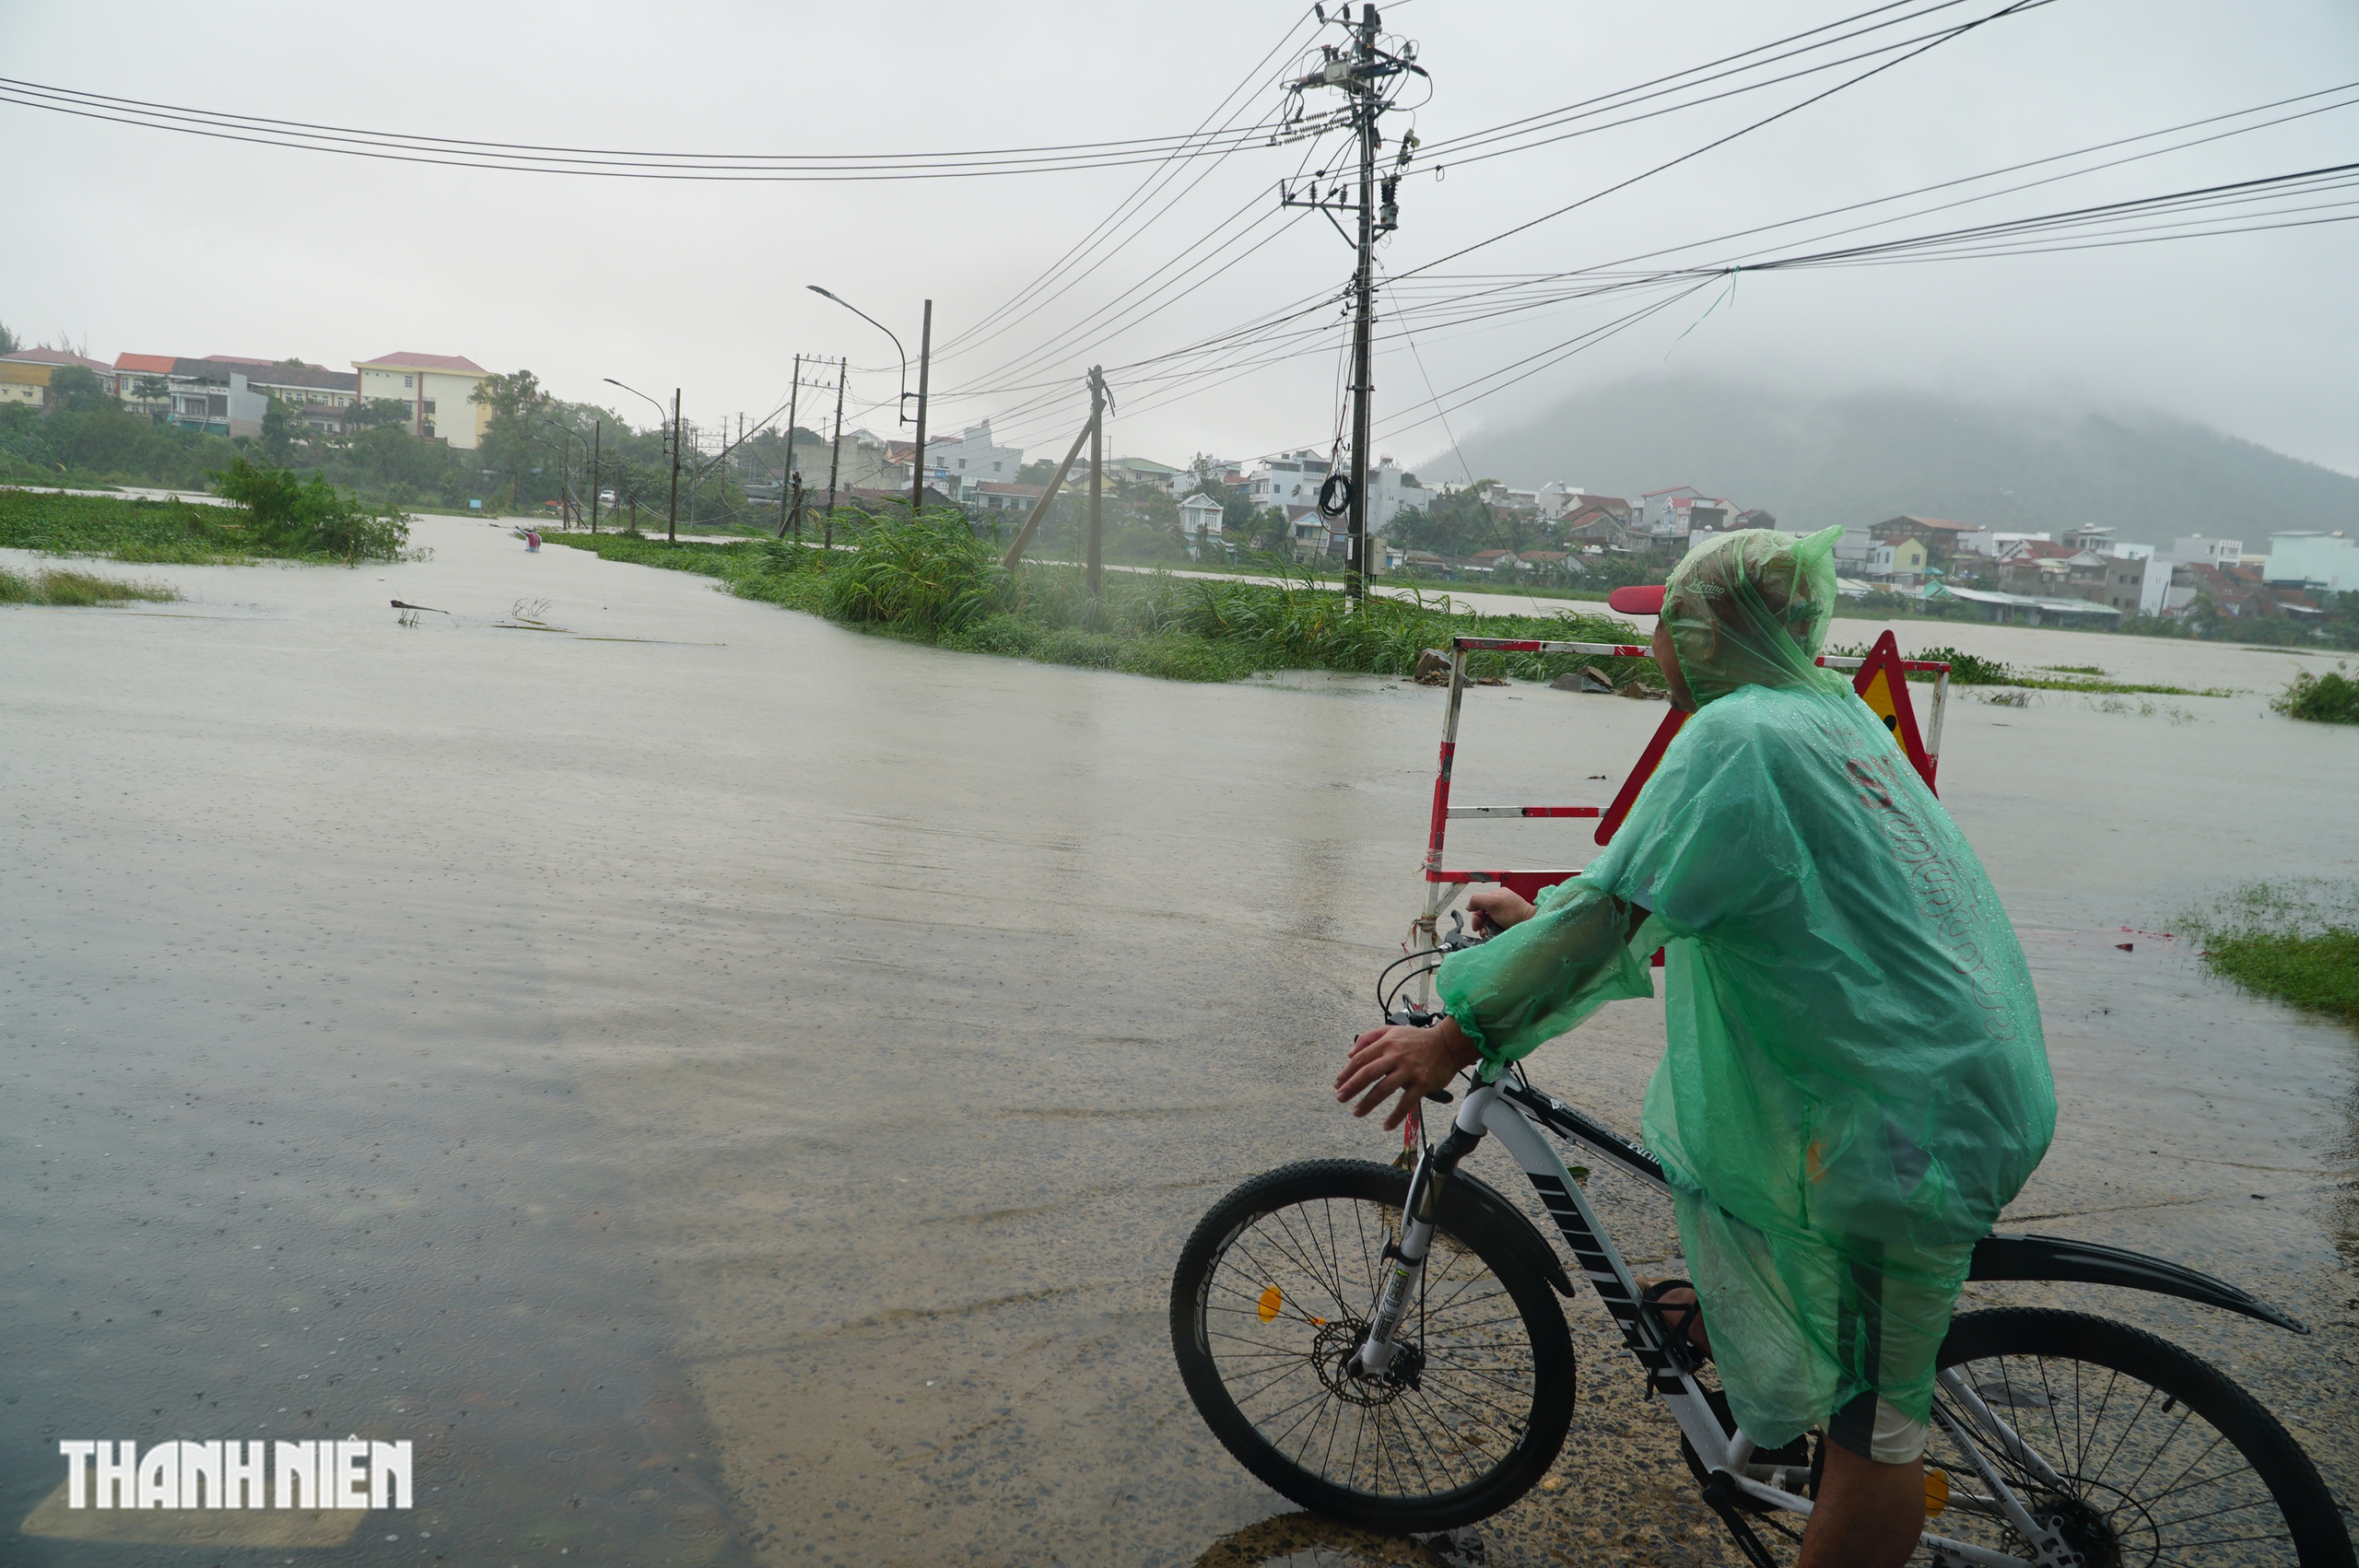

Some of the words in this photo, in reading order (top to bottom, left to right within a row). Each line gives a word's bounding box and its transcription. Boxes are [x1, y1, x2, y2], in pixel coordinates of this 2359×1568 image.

[1950, 1434, 1970, 1456] SUPER
[1966, 1455, 1980, 1471] LITE
[1975, 1467, 2008, 1504] ALUMINIUM
